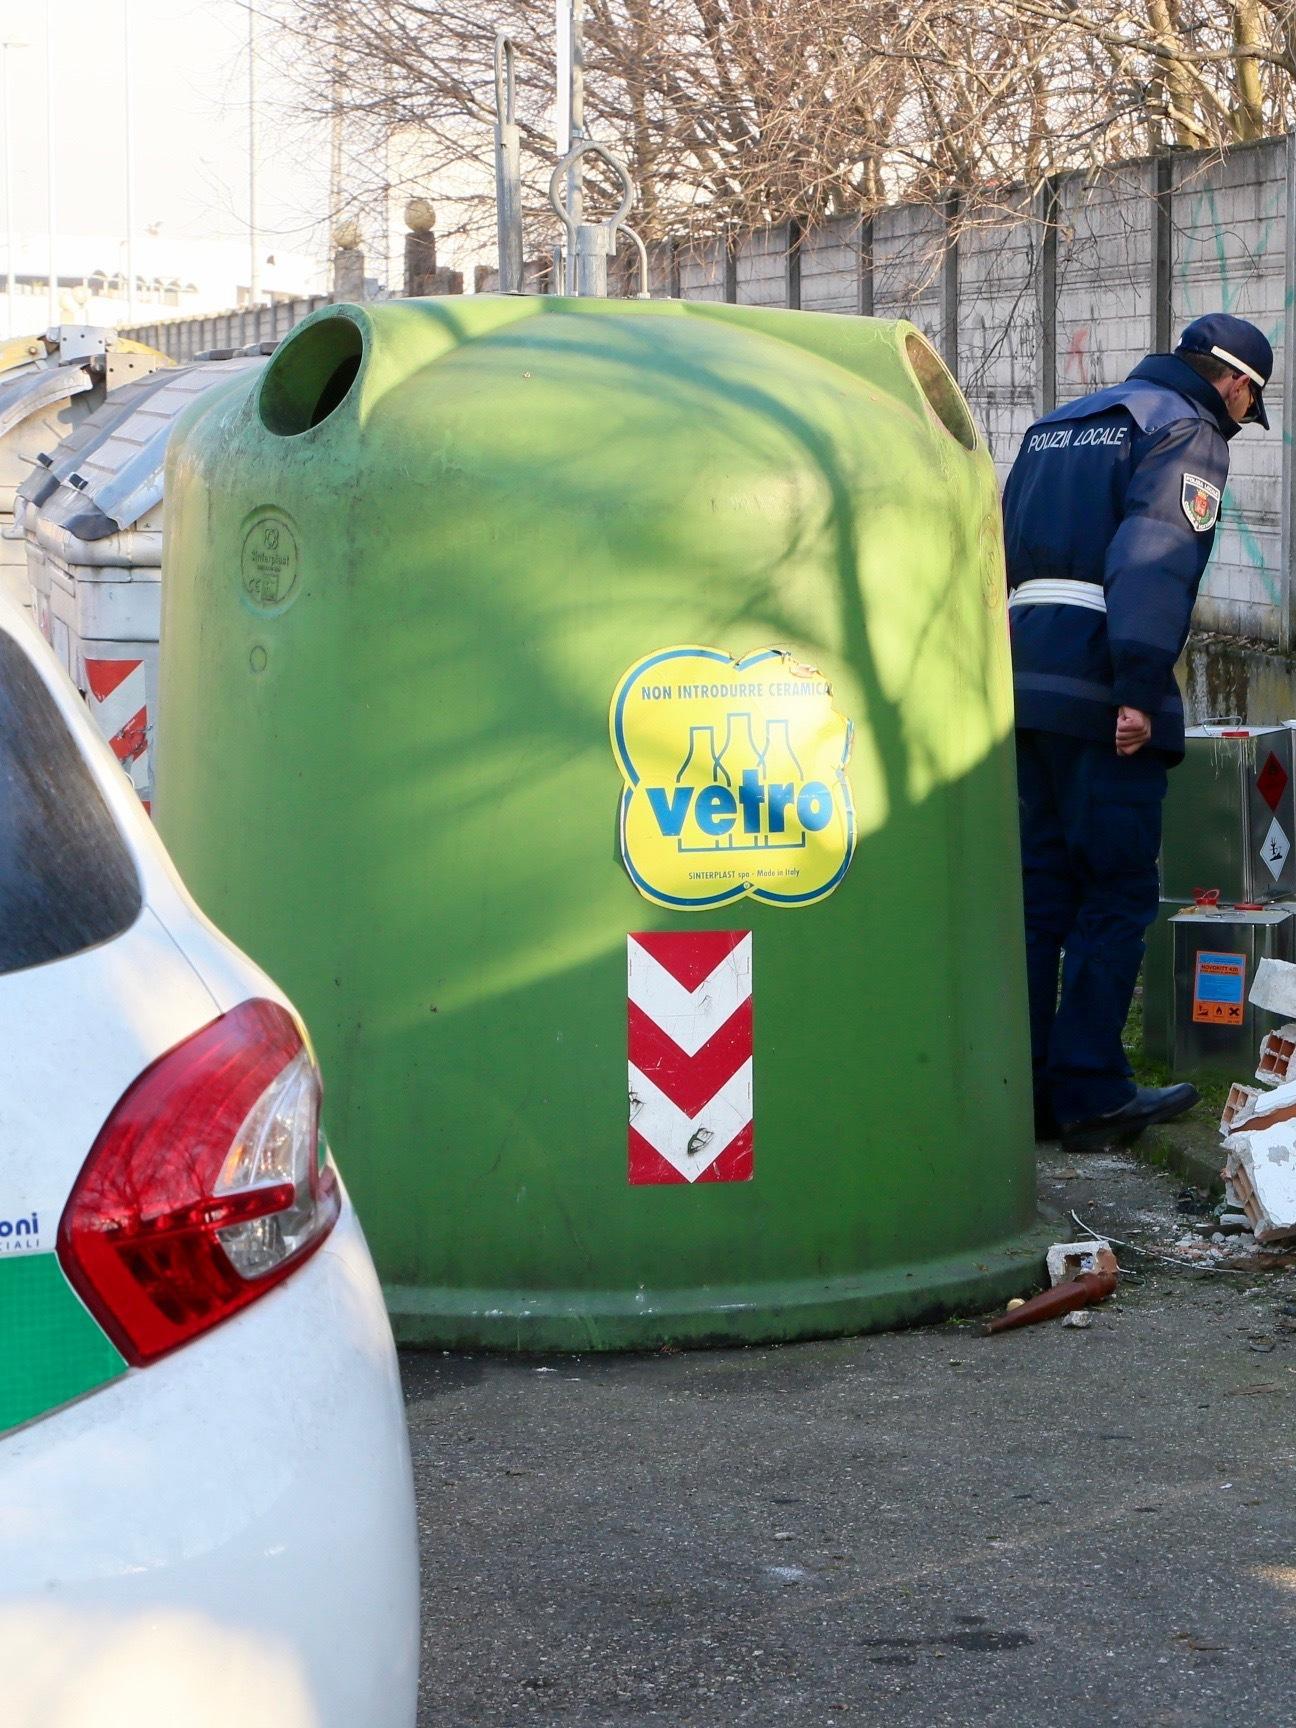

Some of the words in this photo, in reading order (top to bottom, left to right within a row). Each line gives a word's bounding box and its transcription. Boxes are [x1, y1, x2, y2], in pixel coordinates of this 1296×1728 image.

[1027, 429, 1073, 454] POLIZIA
[1073, 427, 1128, 446] LOCALE
[641, 686, 672, 700] NON
[677, 683, 763, 699] INTRODURRE
[645, 769, 833, 836] vetro
[688, 870, 735, 880] SINTERPLAST
[738, 872, 750, 880] spa
[757, 869, 776, 877] Made
[785, 867, 800, 877] Italy
[0, 1238, 40, 1251] IALI
